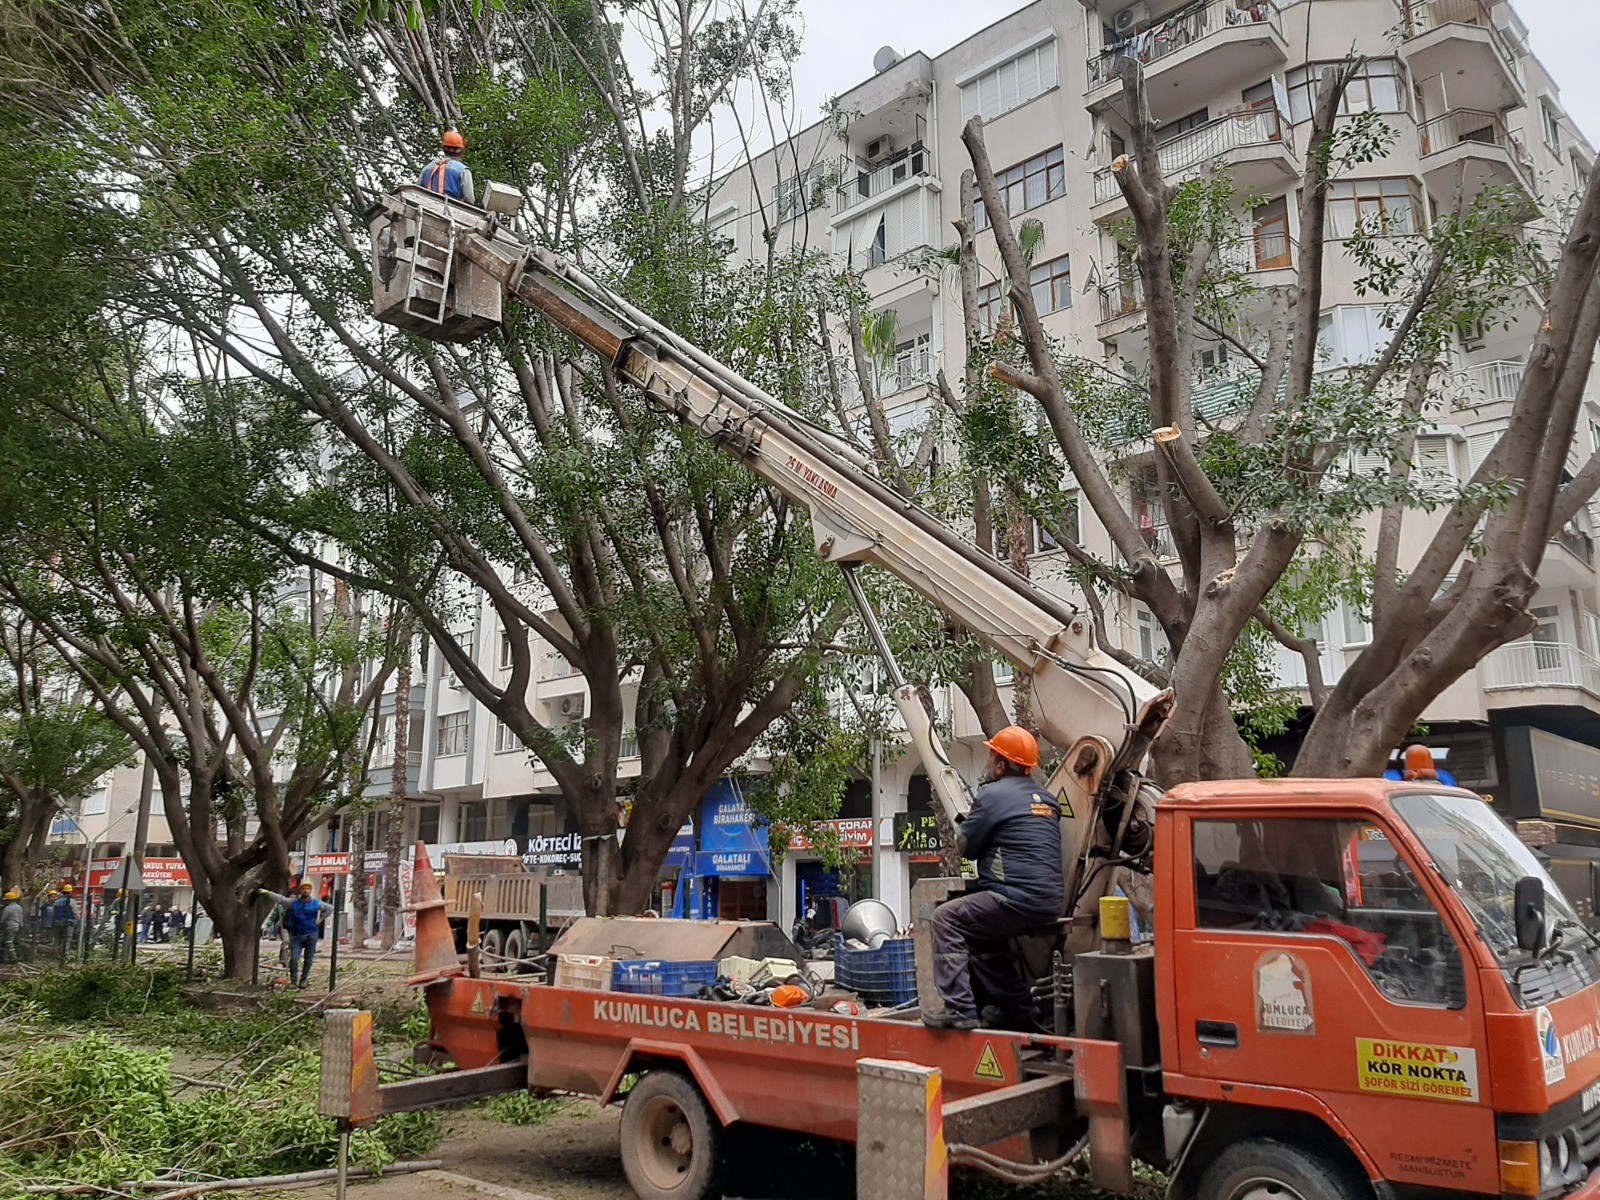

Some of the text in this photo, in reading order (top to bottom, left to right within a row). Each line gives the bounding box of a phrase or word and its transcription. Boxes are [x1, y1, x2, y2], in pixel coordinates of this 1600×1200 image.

[528, 833, 572, 853] KÖFTECİ
[322, 855, 348, 866] EMLAK
[712, 853, 751, 865] GALATALI
[593, 999, 861, 1051] KUMLUCA BELEDİYESİ
[1367, 1060, 1468, 1083] KÖR NOKTA
[1364, 1076, 1473, 1097] ŞOFÖR SİZİ GÖREMEZ
